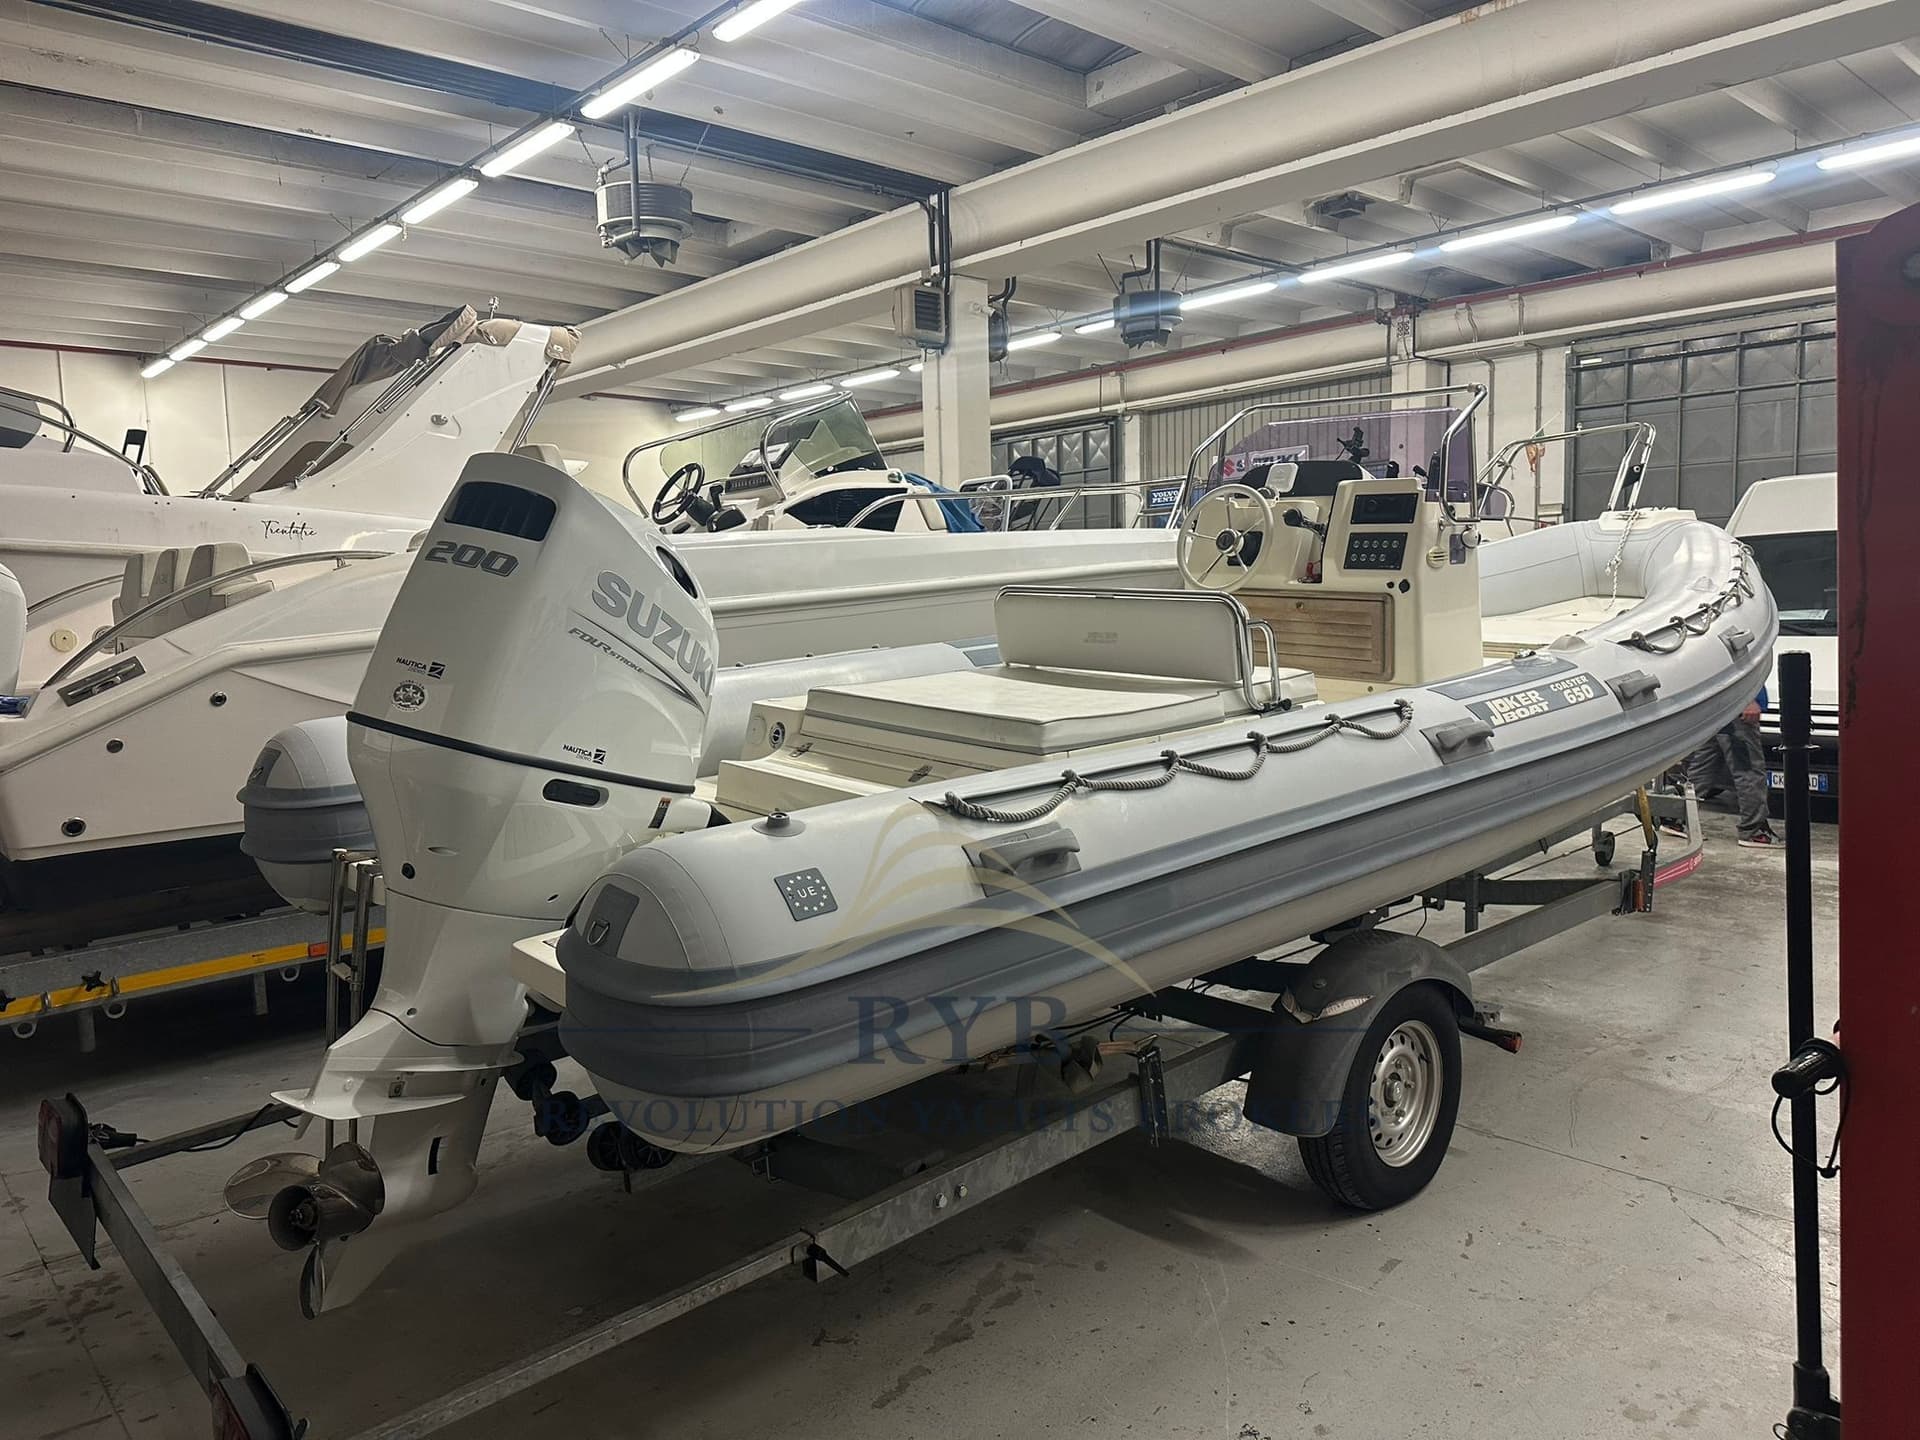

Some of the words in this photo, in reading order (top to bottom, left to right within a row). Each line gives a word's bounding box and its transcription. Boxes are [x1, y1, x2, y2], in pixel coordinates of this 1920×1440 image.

[1152, 490, 1179, 498] VOLVO
[424, 540, 519, 577] 200
[592, 571, 713, 697] SUZUKI
[396, 657, 427, 670] NAUTICA
[1550, 675, 1588, 691] COASTER
[1563, 684, 1594, 704] 650
[1484, 690, 1545, 726] JOKER
[1502, 701, 1549, 723] BOAT
[562, 744, 593, 757] NAUTICA
[797, 886, 818, 898] UE
